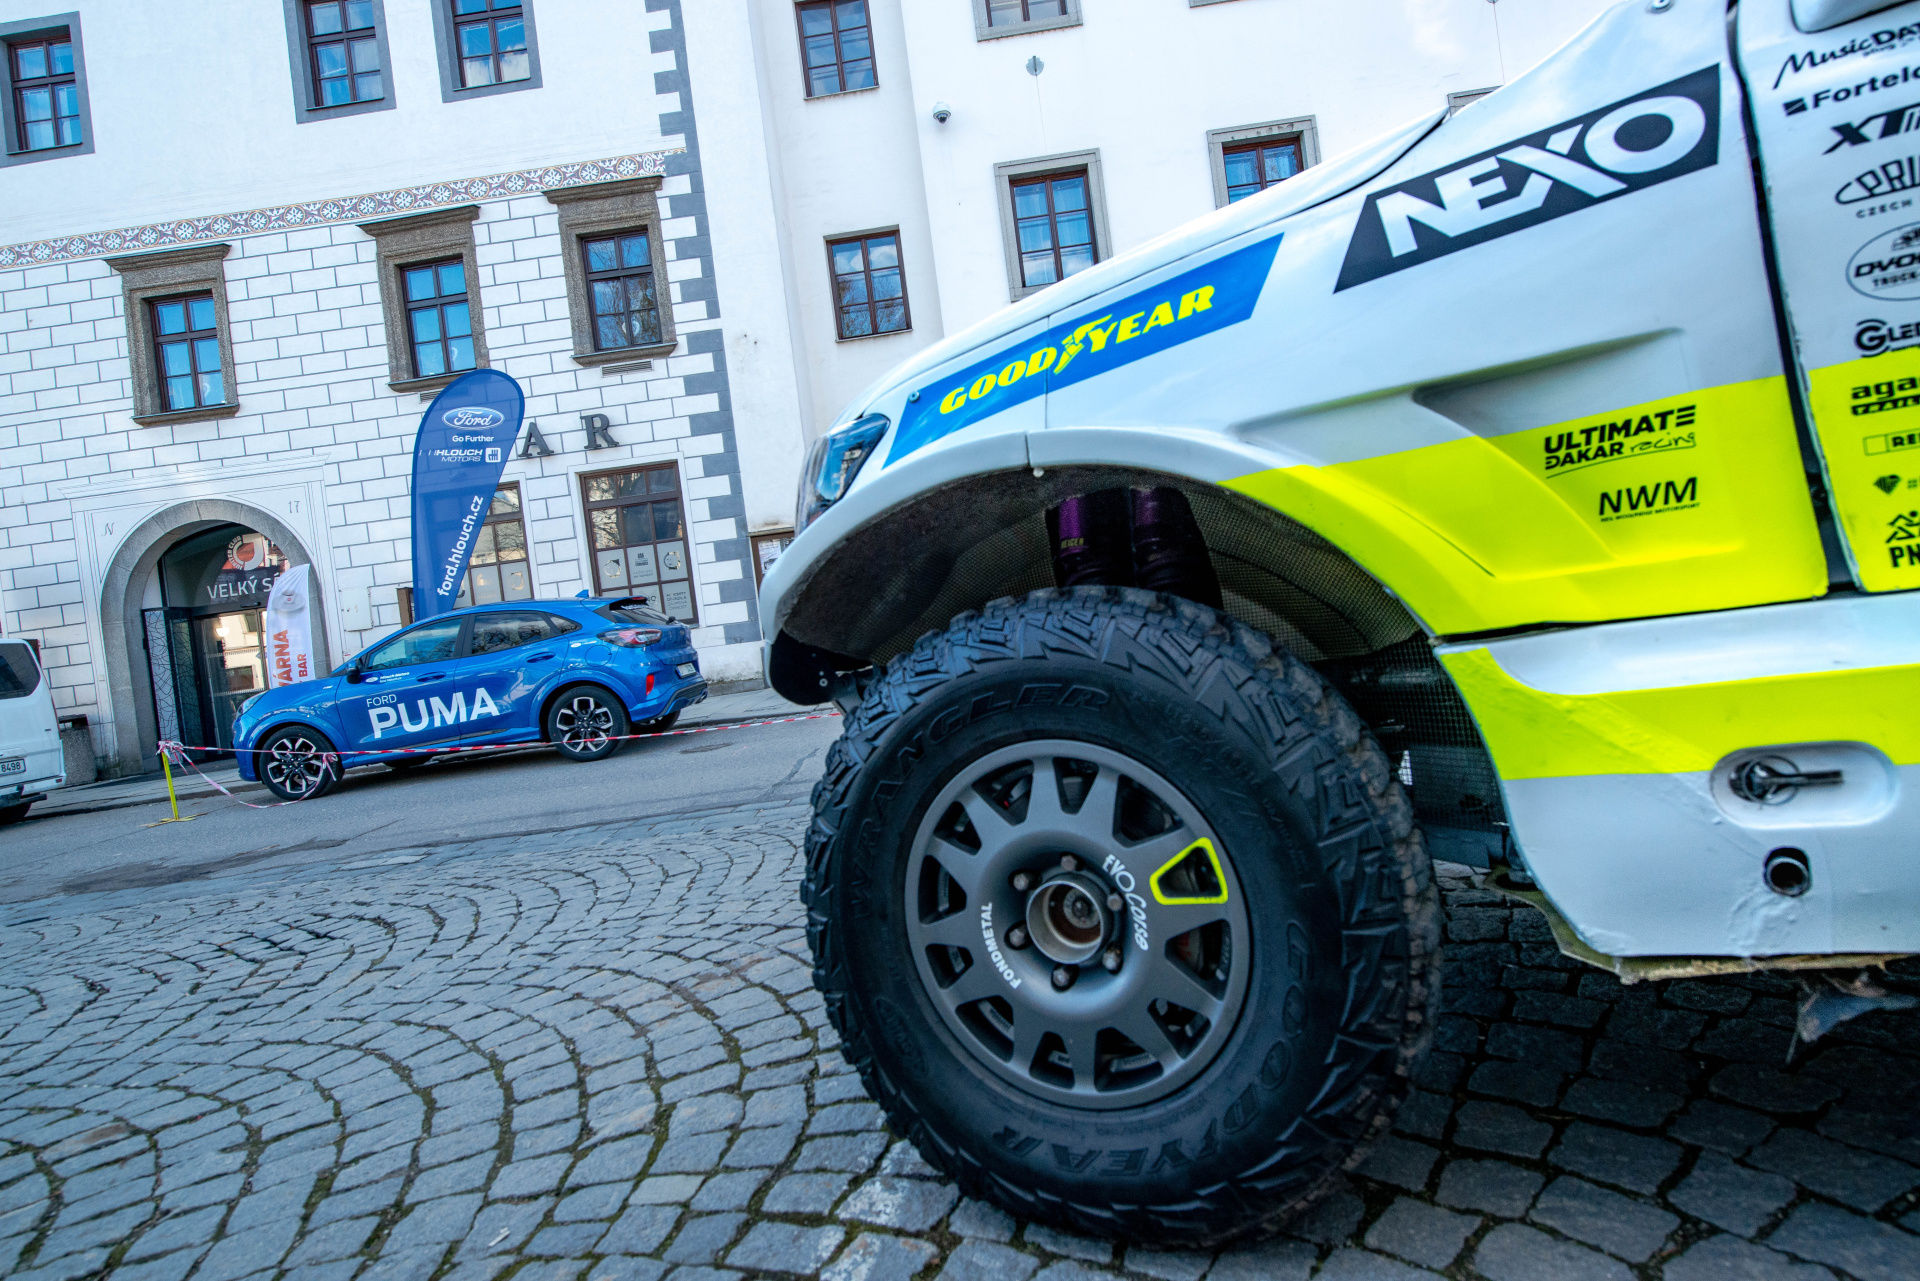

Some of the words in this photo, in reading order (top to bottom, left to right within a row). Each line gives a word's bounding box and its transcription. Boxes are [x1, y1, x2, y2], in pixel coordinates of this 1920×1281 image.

[1375, 95, 1706, 259] NEXO
[939, 285, 1215, 415] GOODYEAR
[453, 410, 494, 426] Ford
[1544, 404, 1697, 454] ULTIMATE
[435, 449, 484, 457] HLOUCH
[452, 435, 465, 443] Go
[466, 434, 495, 443] Further
[1545, 441, 1625, 471] DAKAR
[1599, 476, 1698, 516] NWM
[436, 495, 484, 596] ford.hlouch.cz
[207, 575, 258, 599] VELKÝ
[297, 653, 308, 678] BAR
[366, 693, 397, 708] FORD
[368, 687, 501, 739] PUMA
[1102, 853, 1136, 893] EVO
[980, 902, 1021, 989] FONDMETAL
